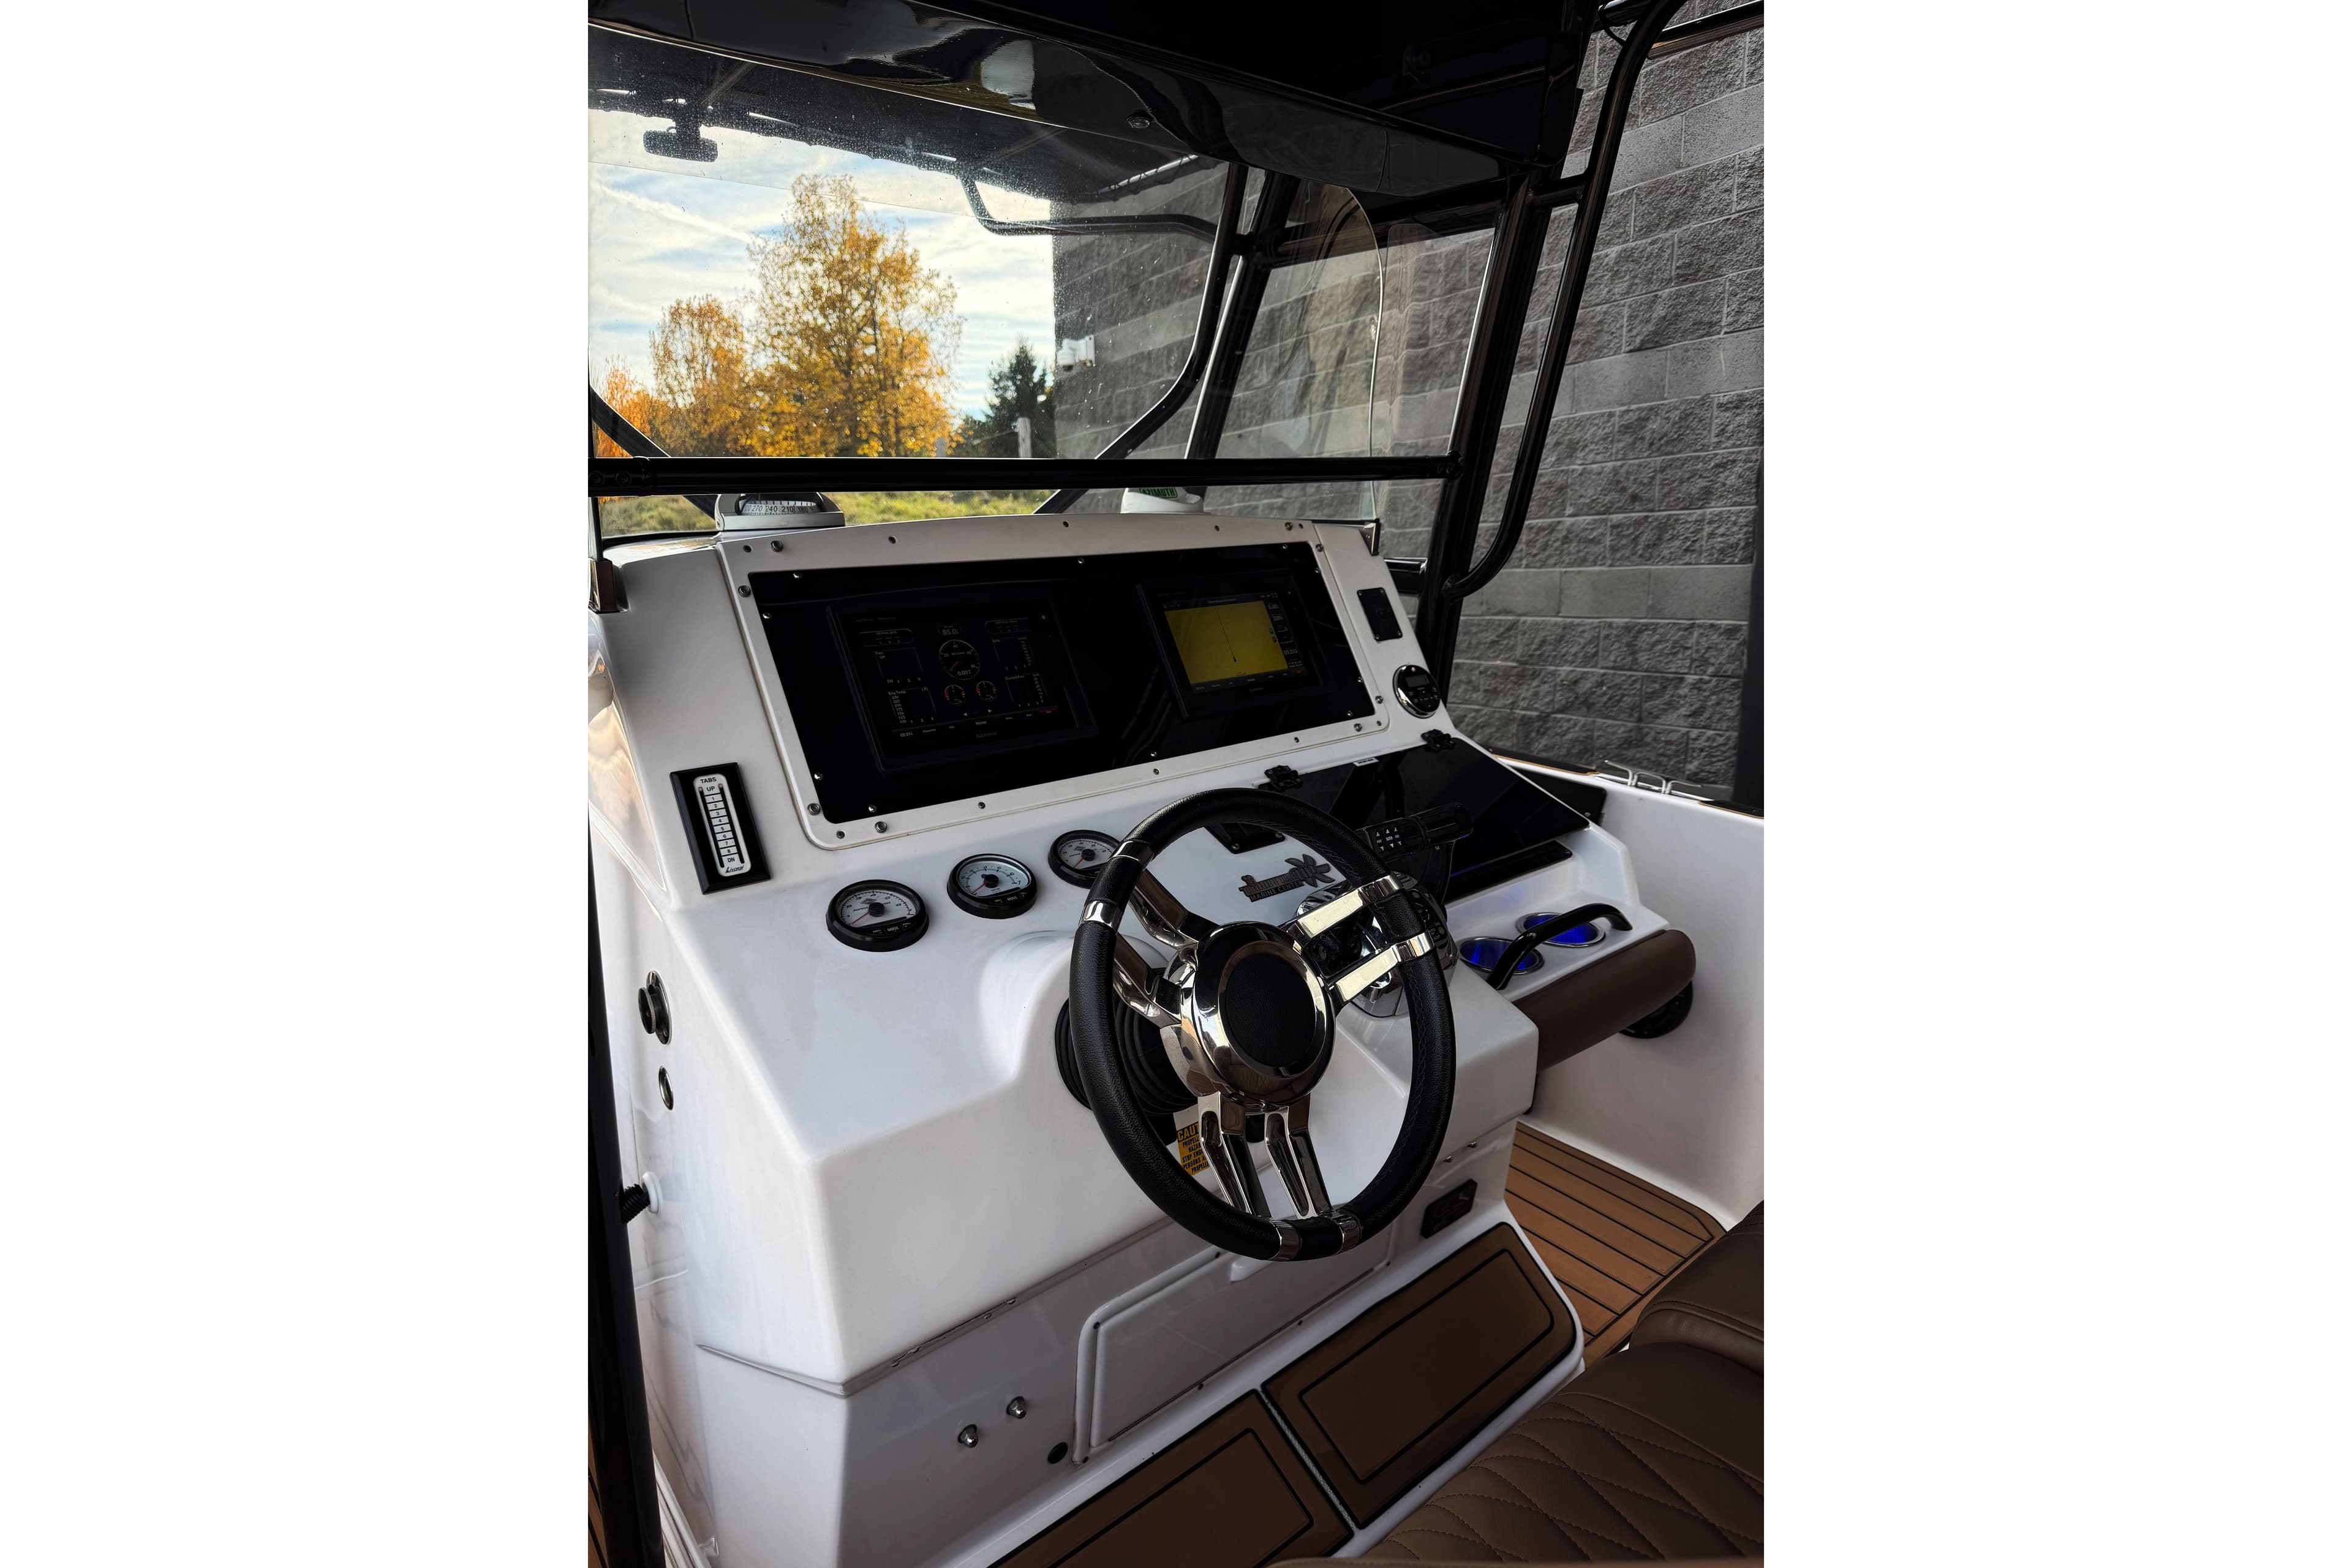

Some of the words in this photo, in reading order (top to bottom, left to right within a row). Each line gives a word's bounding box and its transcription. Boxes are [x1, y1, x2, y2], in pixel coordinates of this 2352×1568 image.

[1250, 888, 1276, 901] MARINE
[1278, 880, 1303, 892] CENTER
[1177, 1123, 1199, 1141] CAUT
[1182, 1154, 1192, 1163] STOP
